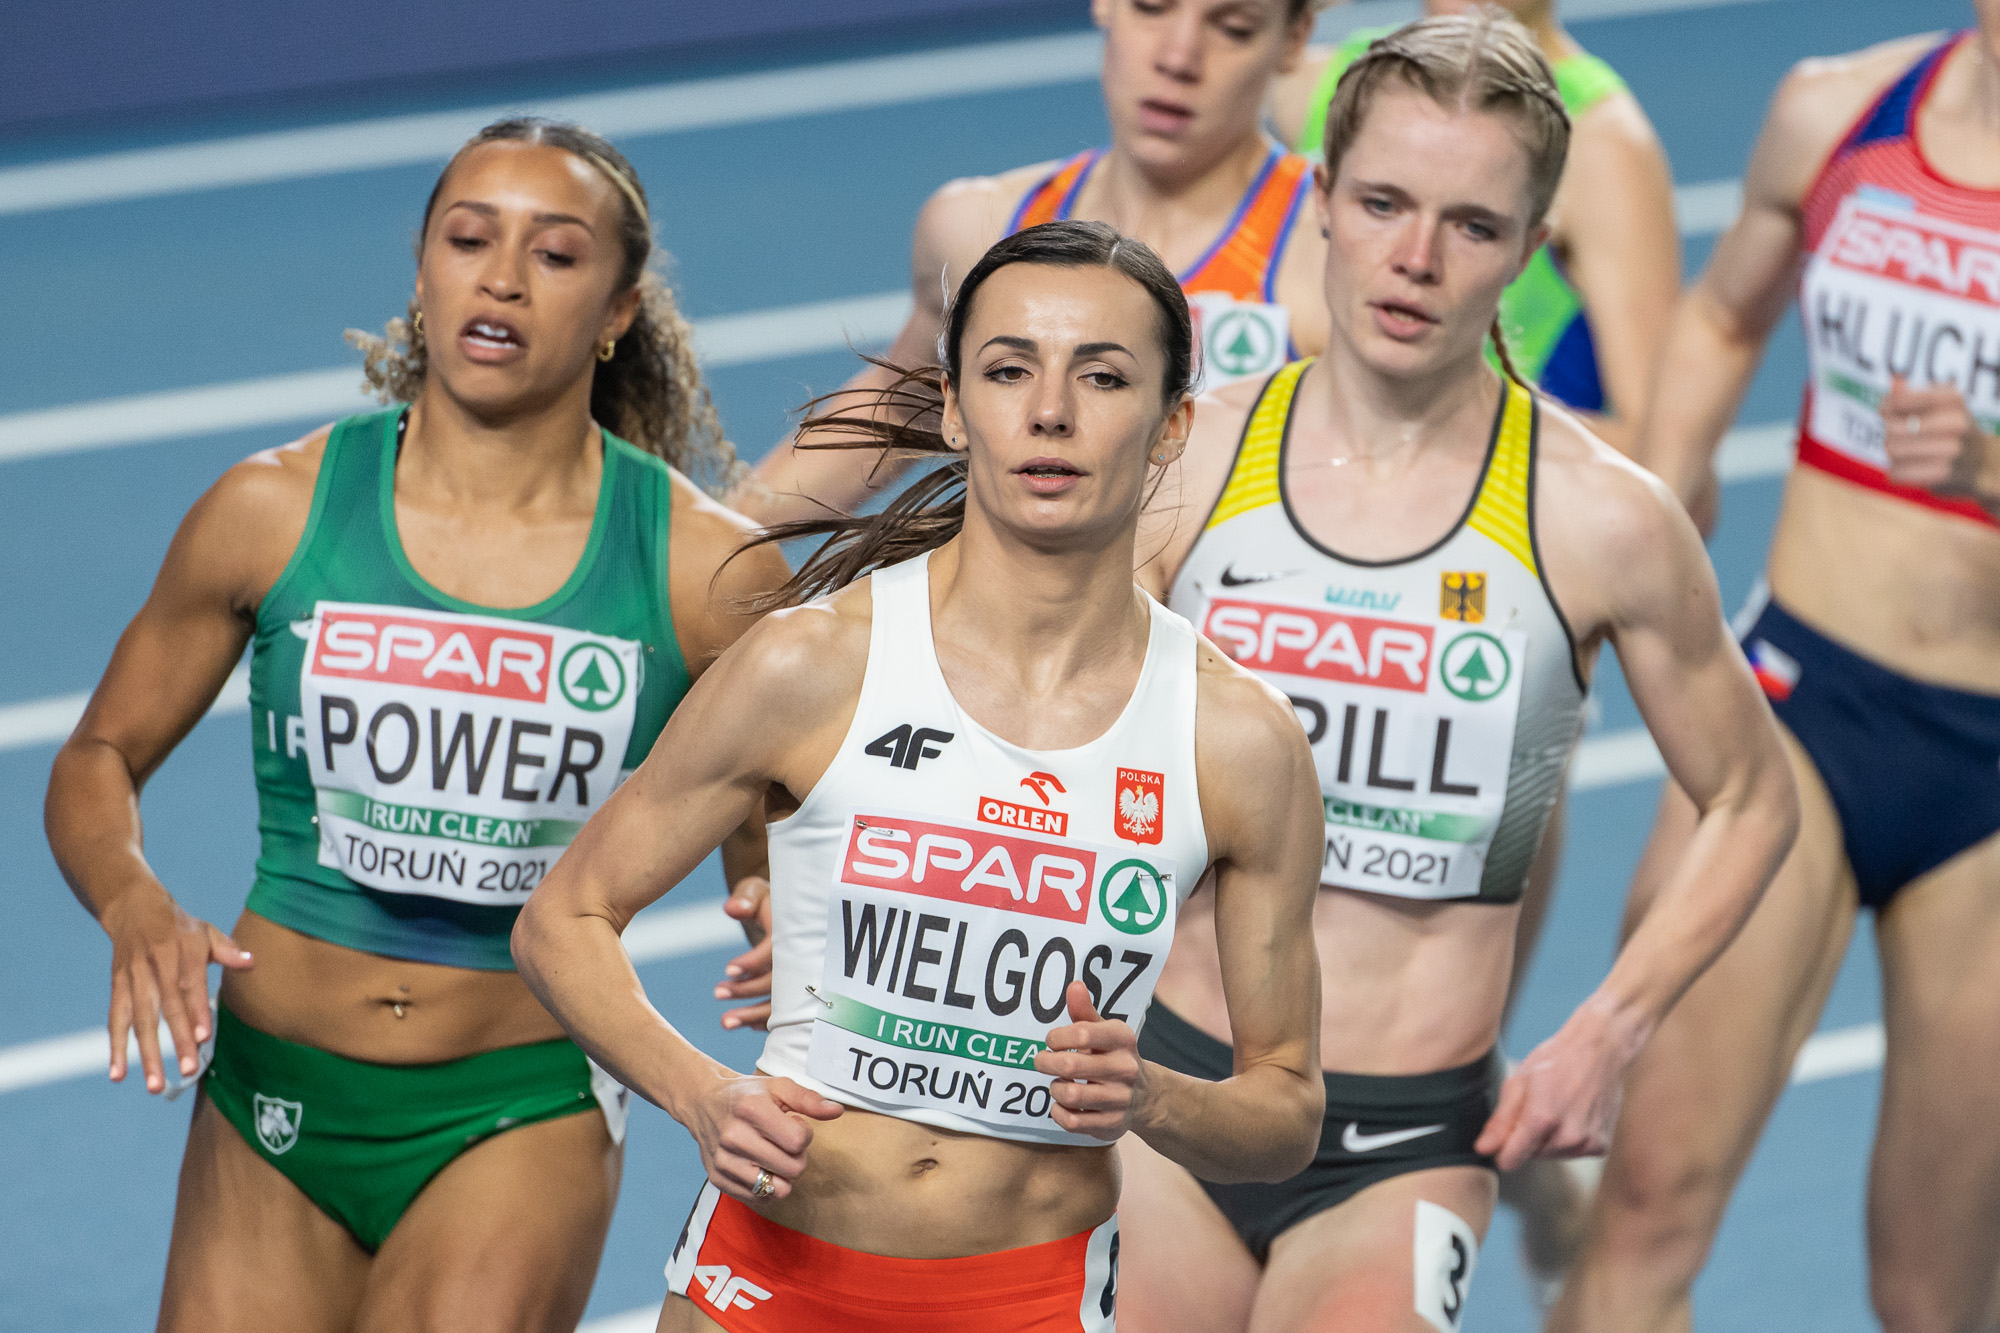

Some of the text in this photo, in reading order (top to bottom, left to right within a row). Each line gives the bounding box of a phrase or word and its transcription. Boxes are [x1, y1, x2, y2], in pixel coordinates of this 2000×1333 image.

[1838, 218, 2000, 302] SPAR
[320, 620, 546, 694] SPAR
[1209, 606, 1428, 685] SPAR
[320, 694, 606, 806] POWER
[864, 723, 955, 771] 4F
[1120, 771, 1161, 785] POLSKA
[363, 800, 370, 823] I
[371, 803, 432, 834] RUN
[983, 801, 1063, 834] ORLEN
[345, 834, 548, 893] TORUŃ 2021
[852, 828, 1087, 912] SPAR
[1362, 844, 1450, 885] 2021
[841, 900, 1153, 1025] WIELGOSZ
[877, 1014, 1053, 1065] I RUN CLEA
[848, 1047, 1053, 1118] TORUŃ 20
[694, 1265, 774, 1313] 4F
[1443, 1233, 1467, 1325] 3
